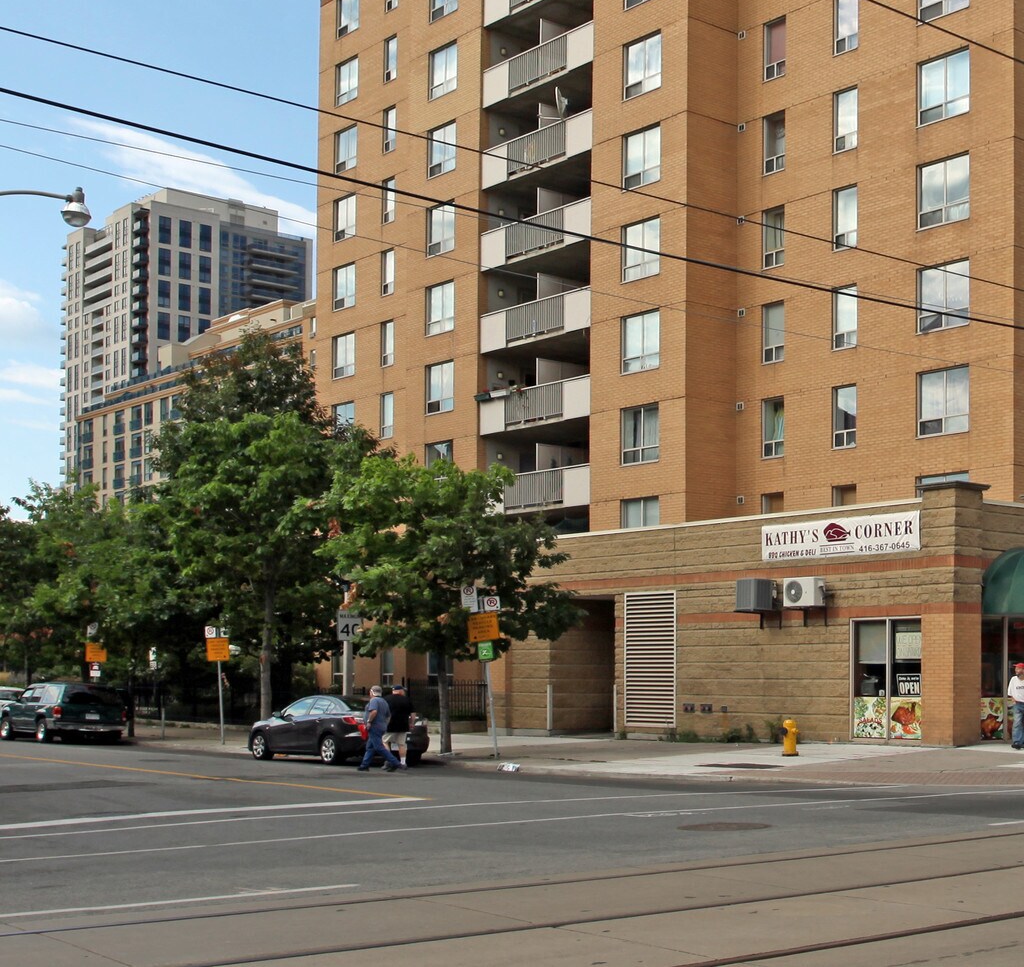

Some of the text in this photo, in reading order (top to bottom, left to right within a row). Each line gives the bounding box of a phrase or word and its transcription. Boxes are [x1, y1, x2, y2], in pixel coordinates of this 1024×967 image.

[765, 520, 913, 546] KATHY'S CORNER
[838, 544, 855, 552] TOWN
[859, 542, 910, 552] 416-367-0645
[779, 550, 799, 558] CHICKEN
[805, 548, 817, 556] DELI
[899, 681, 920, 695] OPEN
